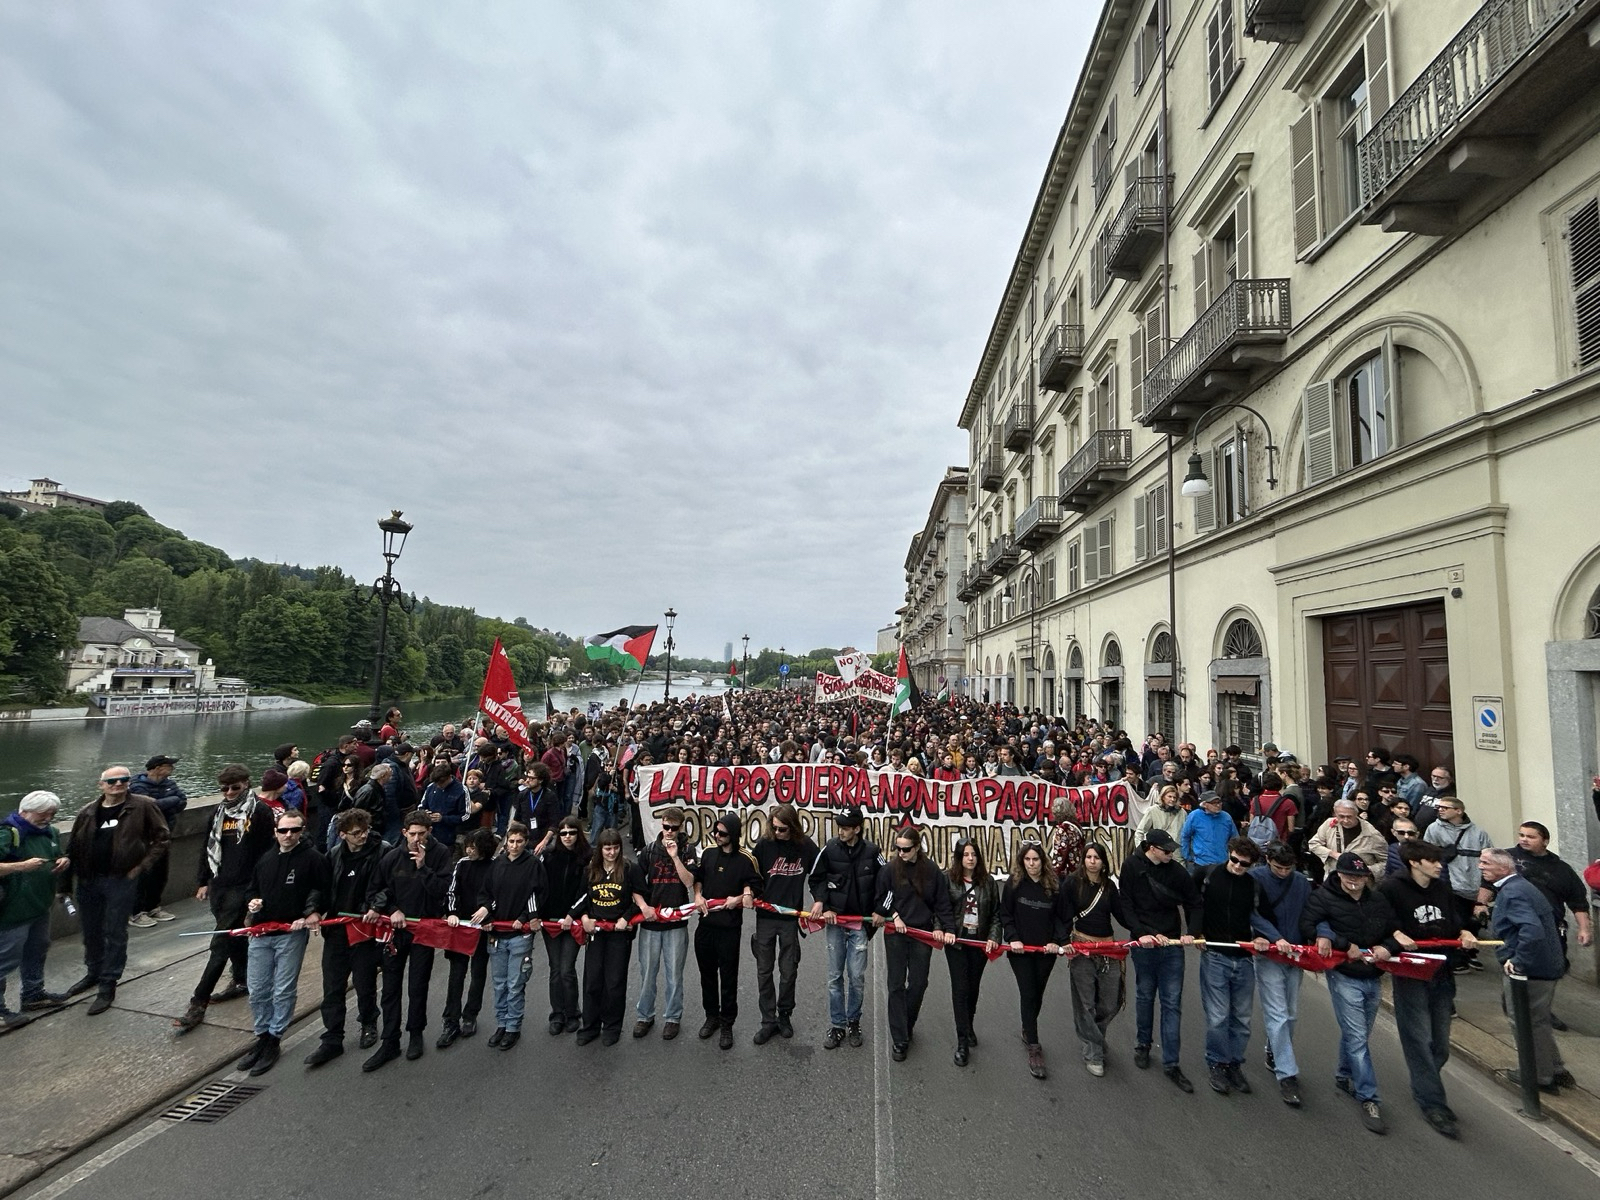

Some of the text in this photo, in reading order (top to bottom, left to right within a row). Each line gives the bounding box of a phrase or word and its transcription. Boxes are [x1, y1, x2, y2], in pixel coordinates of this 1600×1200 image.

[1453, 572, 1459, 580] 2
[839, 657, 853, 667] NO
[649, 766, 693, 807] LA
[698, 766, 771, 808] LORO
[774, 765, 872, 811] GUERRA
[876, 773, 940, 818] NON
[944, 780, 978, 819] LA
[592, 882, 622, 891] REFUGEES
[592, 898, 621, 907] WELCOME
